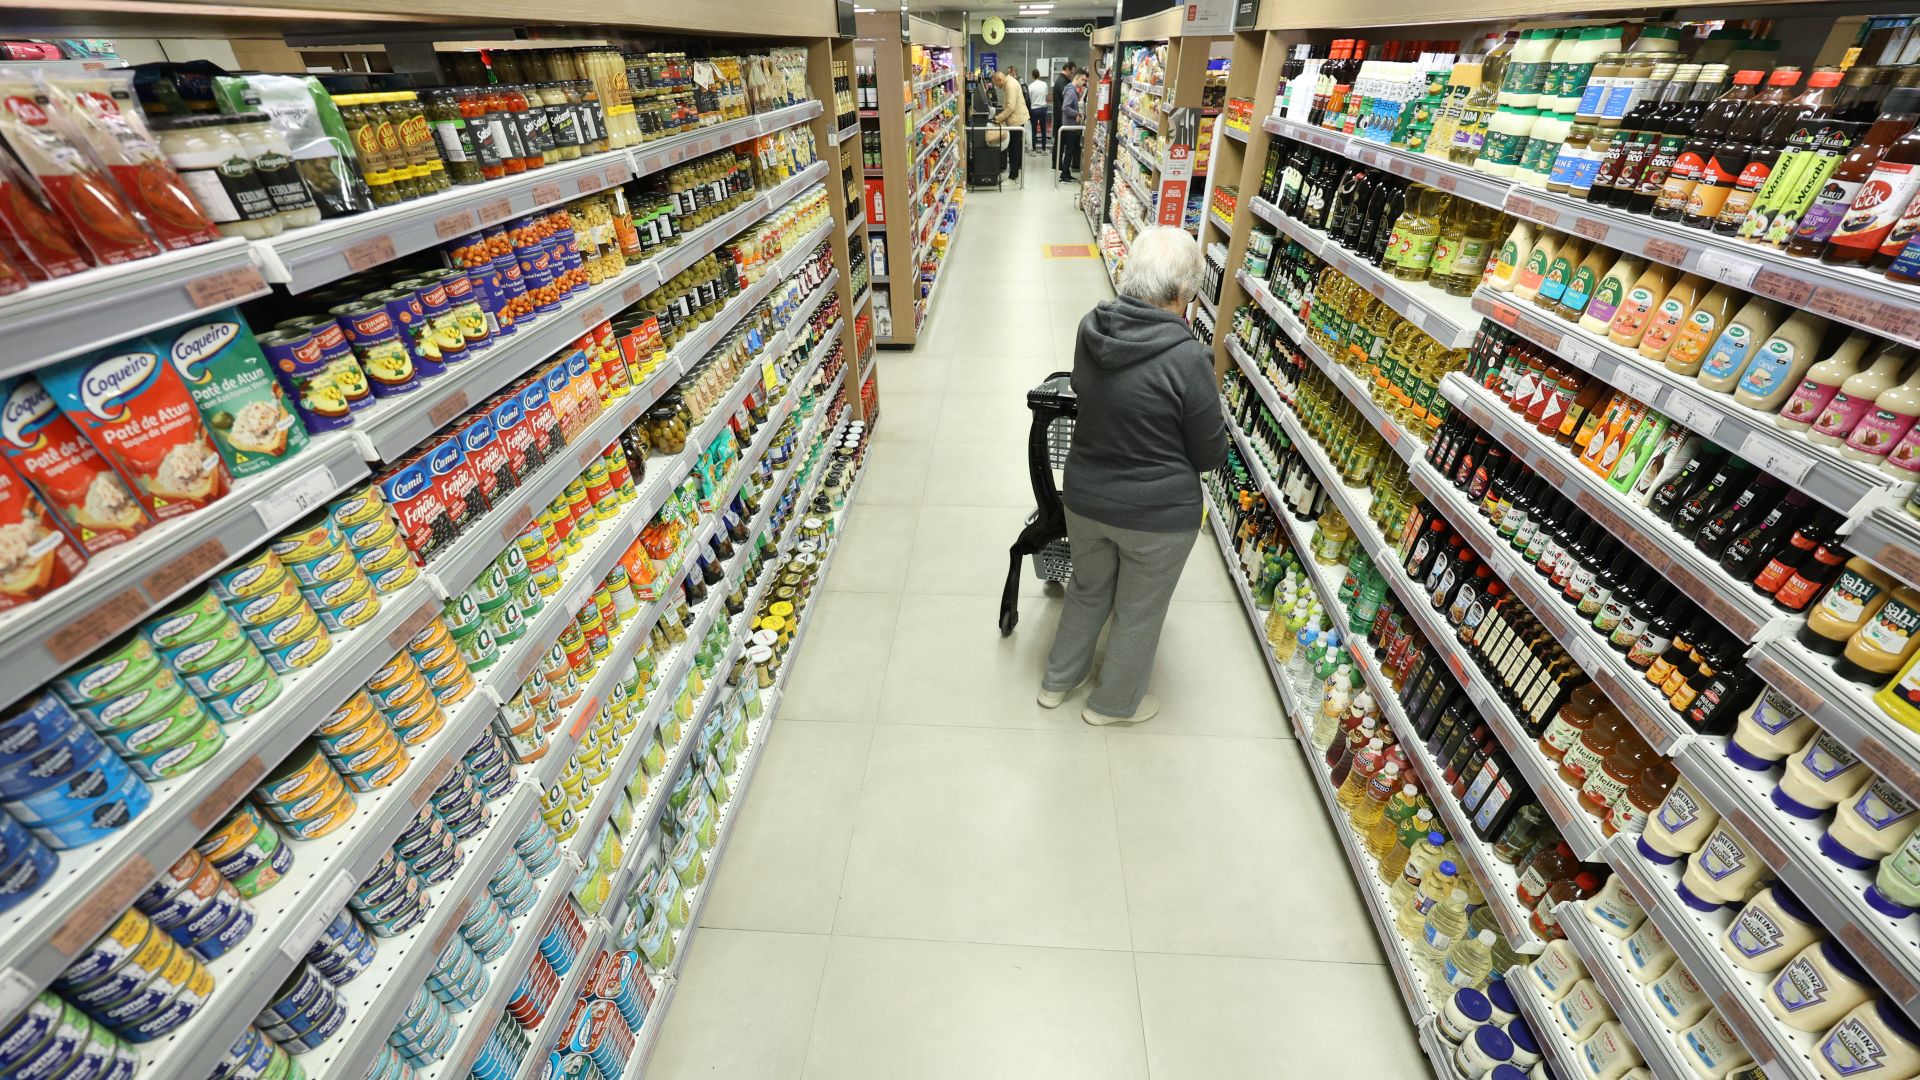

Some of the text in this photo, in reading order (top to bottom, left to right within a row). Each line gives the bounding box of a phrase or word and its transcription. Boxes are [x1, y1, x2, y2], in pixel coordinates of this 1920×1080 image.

[1764, 155, 1793, 199] Wasabi
[1794, 159, 1828, 204] Wasabi
[1555, 259, 1566, 269] Liza
[1578, 268, 1589, 279] Liza
[1605, 278, 1619, 290] Liza
[175, 324, 230, 360] Coqueiro
[87, 355, 148, 396] Coqueiro
[192, 368, 265, 401] Patê de Atum
[526, 390, 544, 408] Camil
[103, 402, 190, 445] Patê de Atum
[500, 408, 520, 427] Camil
[531, 407, 552, 432] Feijão
[469, 427, 490, 447] Camil
[506, 425, 528, 453] Feijão
[434, 449, 458, 471] Camil
[476, 445, 499, 475] Feijão
[396, 473, 423, 497] Camil
[441, 469, 469, 500] Feijão
[405, 493, 436, 527] Feijão
[315, 553, 344, 572] Coqueiro
[231, 566, 265, 588] Coqueiro
[325, 579, 353, 598] Coqueiro
[1841, 573, 1873, 596] sahi
[245, 593, 279, 616] Coqueiro
[340, 599, 368, 619] Coqueiro
[1885, 602, 1920, 627] sahi
[271, 614, 301, 636] Coqueiro
[288, 638, 318, 661] Coqueiro
[1766, 693, 1796, 717] MAIONESE
[1819, 738, 1851, 763] MAIONESE
[1597, 773, 1626, 793] Heinig
[1668, 797, 1689, 820] MAIONESE
[1675, 791, 1696, 811] HEINZ
[1873, 783, 1907, 811] MAIONESE
[1712, 843, 1734, 867] MAIONESE
[1719, 836, 1740, 858] HEINZ
[1743, 917, 1770, 946] MAIONESE
[1753, 910, 1777, 936] HEINZ
[1790, 969, 1814, 1000] MAIONESE
[1800, 963, 1822, 989] HEINZ
[108, 989, 151, 1017] Gomes
[140, 1005, 181, 1032] Gomes
[1839, 1030, 1869, 1065] MAIONESE
[1851, 1023, 1877, 1053] HEINZ
